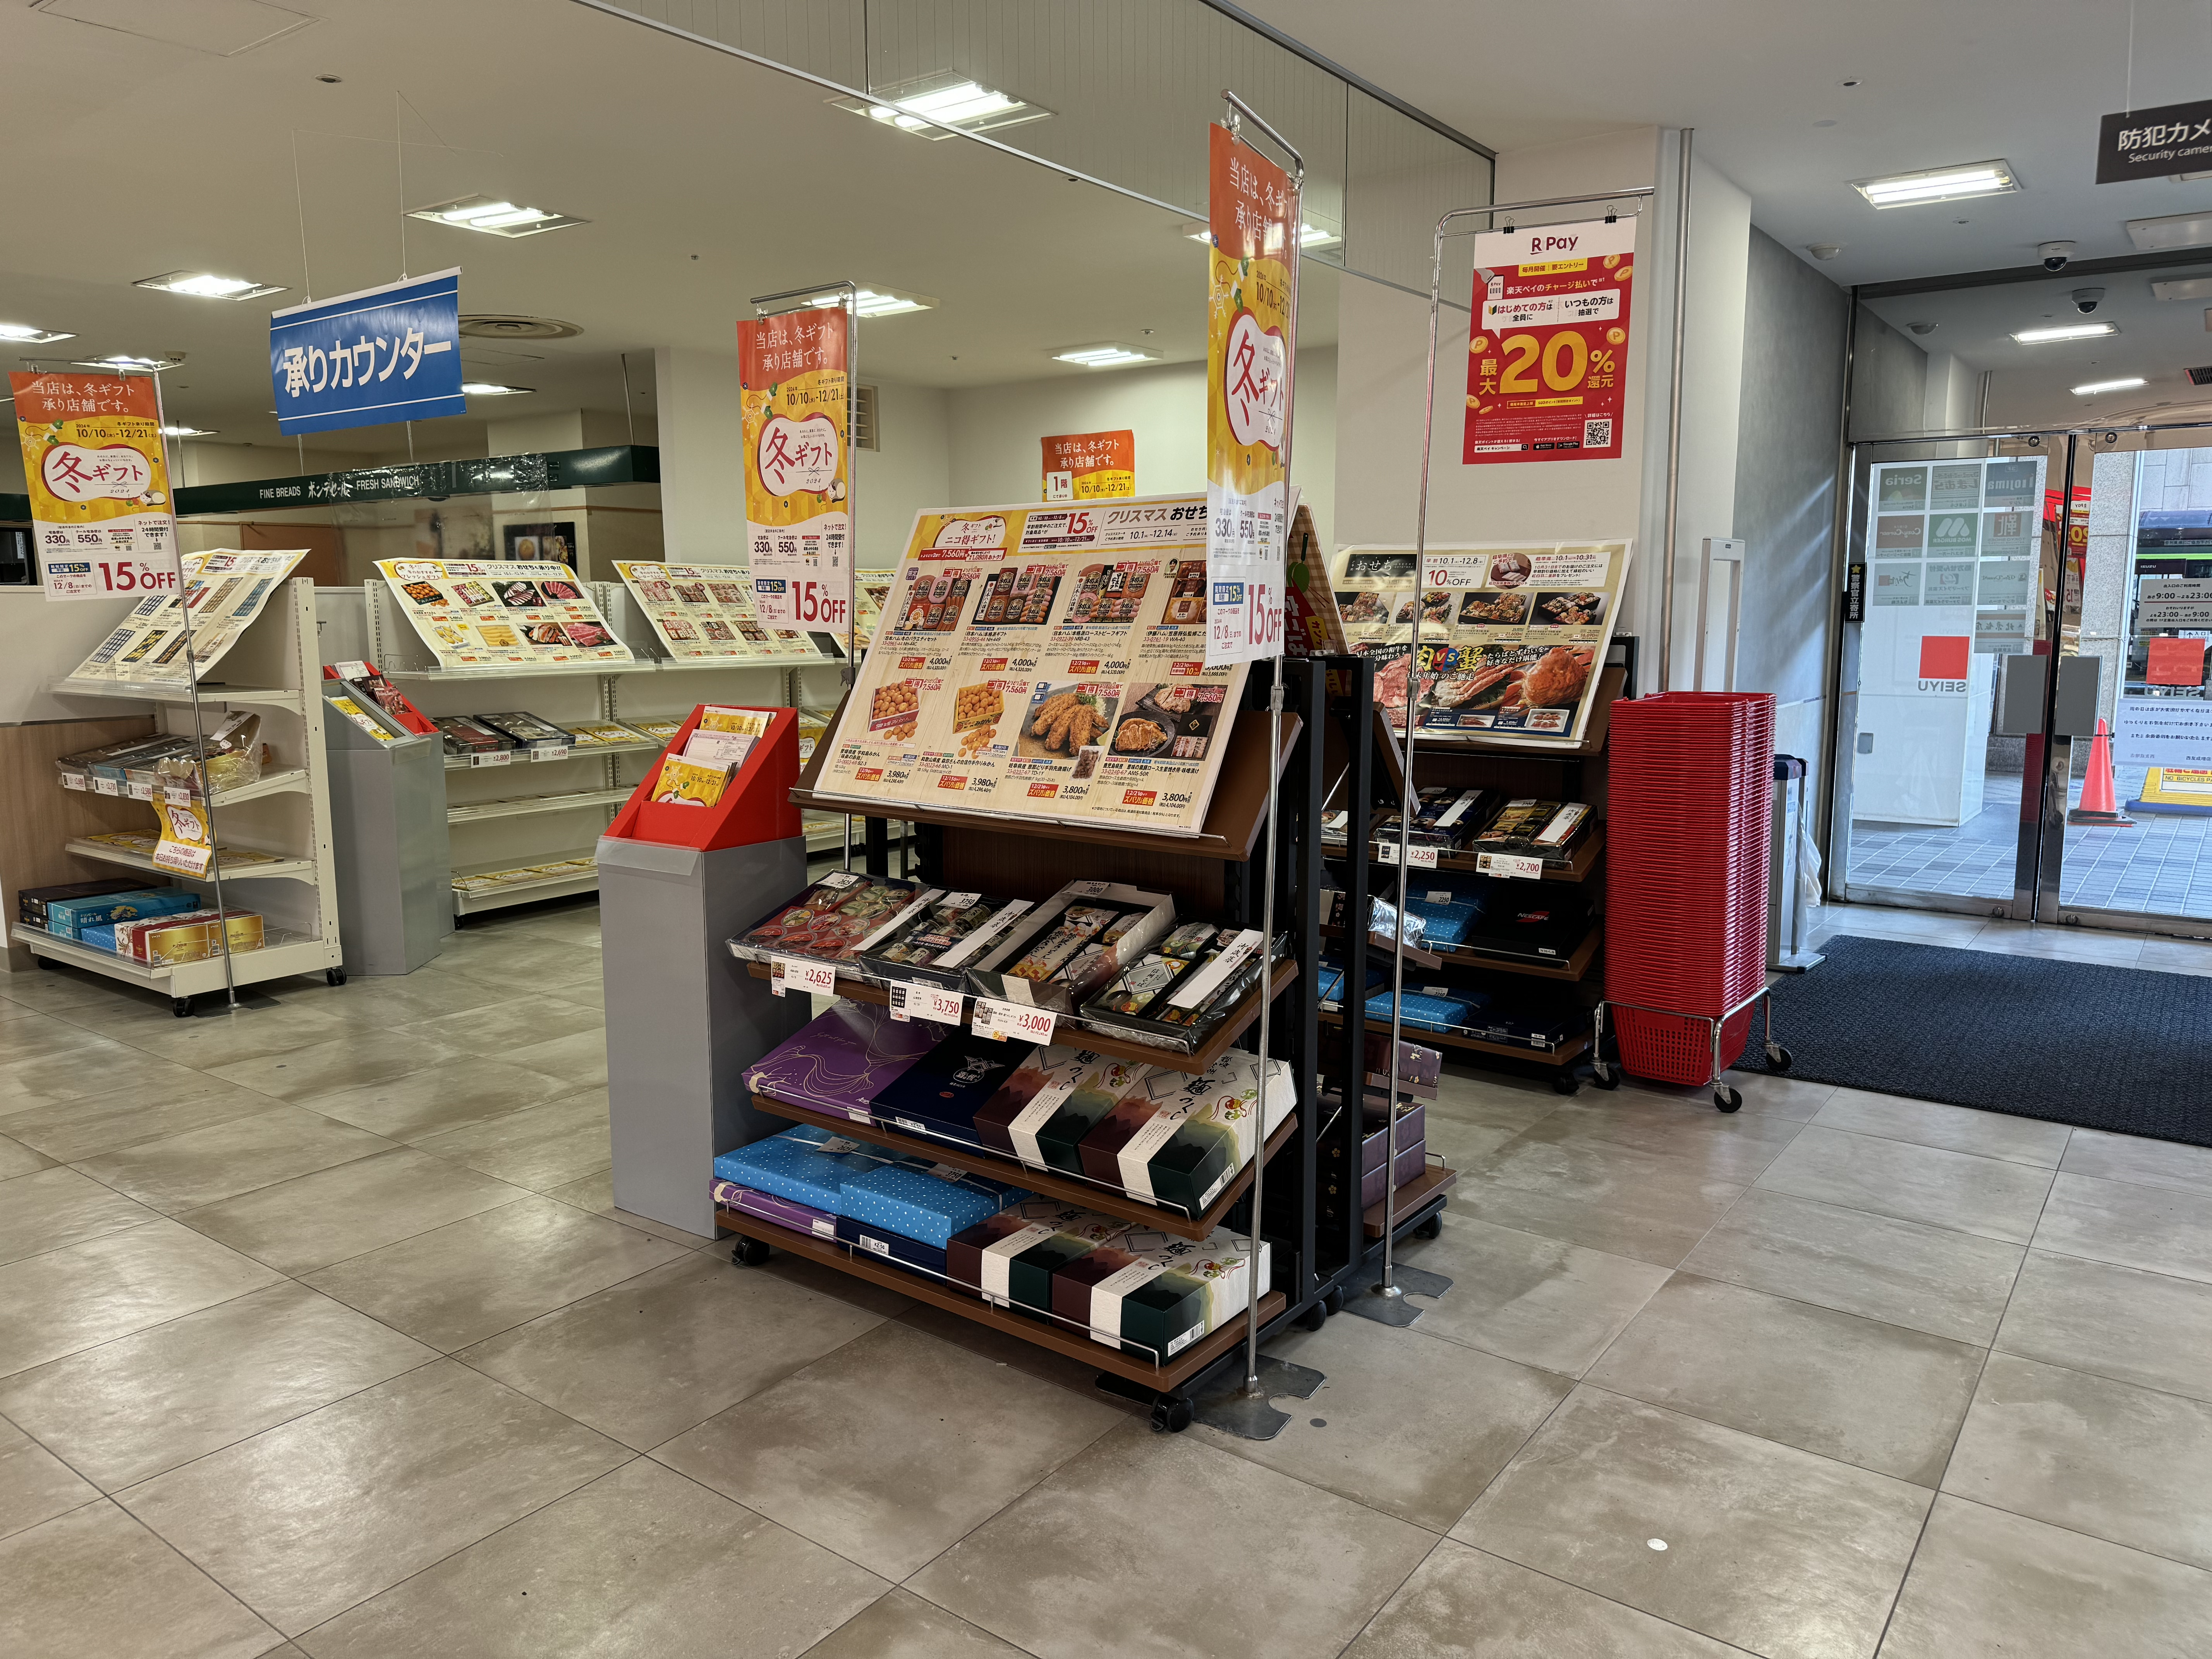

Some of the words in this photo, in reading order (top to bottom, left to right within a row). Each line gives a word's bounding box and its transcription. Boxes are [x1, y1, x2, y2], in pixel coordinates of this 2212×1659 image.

[2128, 149, 2176, 163] Security
[1530, 237, 1544, 255] R
[1546, 236, 1578, 251] Pay
[1522, 265, 1546, 273] 毎月開催
[1506, 280, 1598, 295] 楽天ペイのチャージ払いで
[1498, 302, 1553, 314] はじめての方は
[1565, 296, 1613, 308] いつもの方は
[1578, 308, 1599, 316] 抽選で
[756, 322, 833, 350] 当店は、冬ギフト
[283, 328, 451, 397] 承りカウンター
[763, 347, 827, 372] 承り店舗です。
[817, 376, 844, 385] 冬ギフト承り期間
[1231, 329, 1283, 426] 冬ギフト
[1479, 359, 1497, 395] 最大
[1588, 375, 1613, 388] 還元
[32, 381, 134, 395] 当店は、冬ギフト
[42, 398, 129, 413] 承り店舗です。
[1055, 439, 1119, 454] 当店は、冬ギフト
[765, 427, 832, 484] 冬ギフト
[1060, 454, 1114, 469] 承り店舗です。
[52, 451, 143, 493] 冬ギフト
[357, 479, 379, 491] FRESH
[381, 476, 419, 488] SANDWICH
[1054, 476, 1067, 491] 1階
[259, 489, 274, 499] FINE
[276, 486, 301, 498] BREADS
[1108, 508, 1167, 524] クリスマス
[962, 522, 981, 533] 冬ギフト
[945, 534, 996, 545] ニコ得ギフト!
[1355, 560, 1392, 571] おせち
[1429, 570, 1472, 586] 10%OFF
[1850, 574, 1860, 618] 警察官立寄所
[1437, 653, 1455, 662] VS
[1456, 646, 1483, 672] 蟹
[1486, 653, 1542, 666] 好きなだけ堪能!
[1487, 645, 1545, 660] たらばとずわいを
[1441, 672, 1474, 680] のご馳走
[171, 810, 199, 834] 冬ギフト
[169, 846, 196, 857] こちらの商品は
[1410, 850, 1435, 860] ¥2,250
[156, 853, 204, 870] 本日お持ち帰りいただけます
[1516, 862, 1540, 872] ¥2,700
[81, 915, 103, 924] 晴れ風
[805, 969, 831, 985] ¥2,625
[934, 1000, 959, 1014] ¥3,750
[1019, 1014, 1051, 1032] ¥3,000
[1059, 1049, 1101, 1091] 麺づくし
[1170, 1077, 1216, 1121] 麺づくし
[945, 1170, 962, 1179] 3750
[1037, 1209, 1087, 1235] 麺づくし
[1148, 1241, 1197, 1271] 麺づくし
